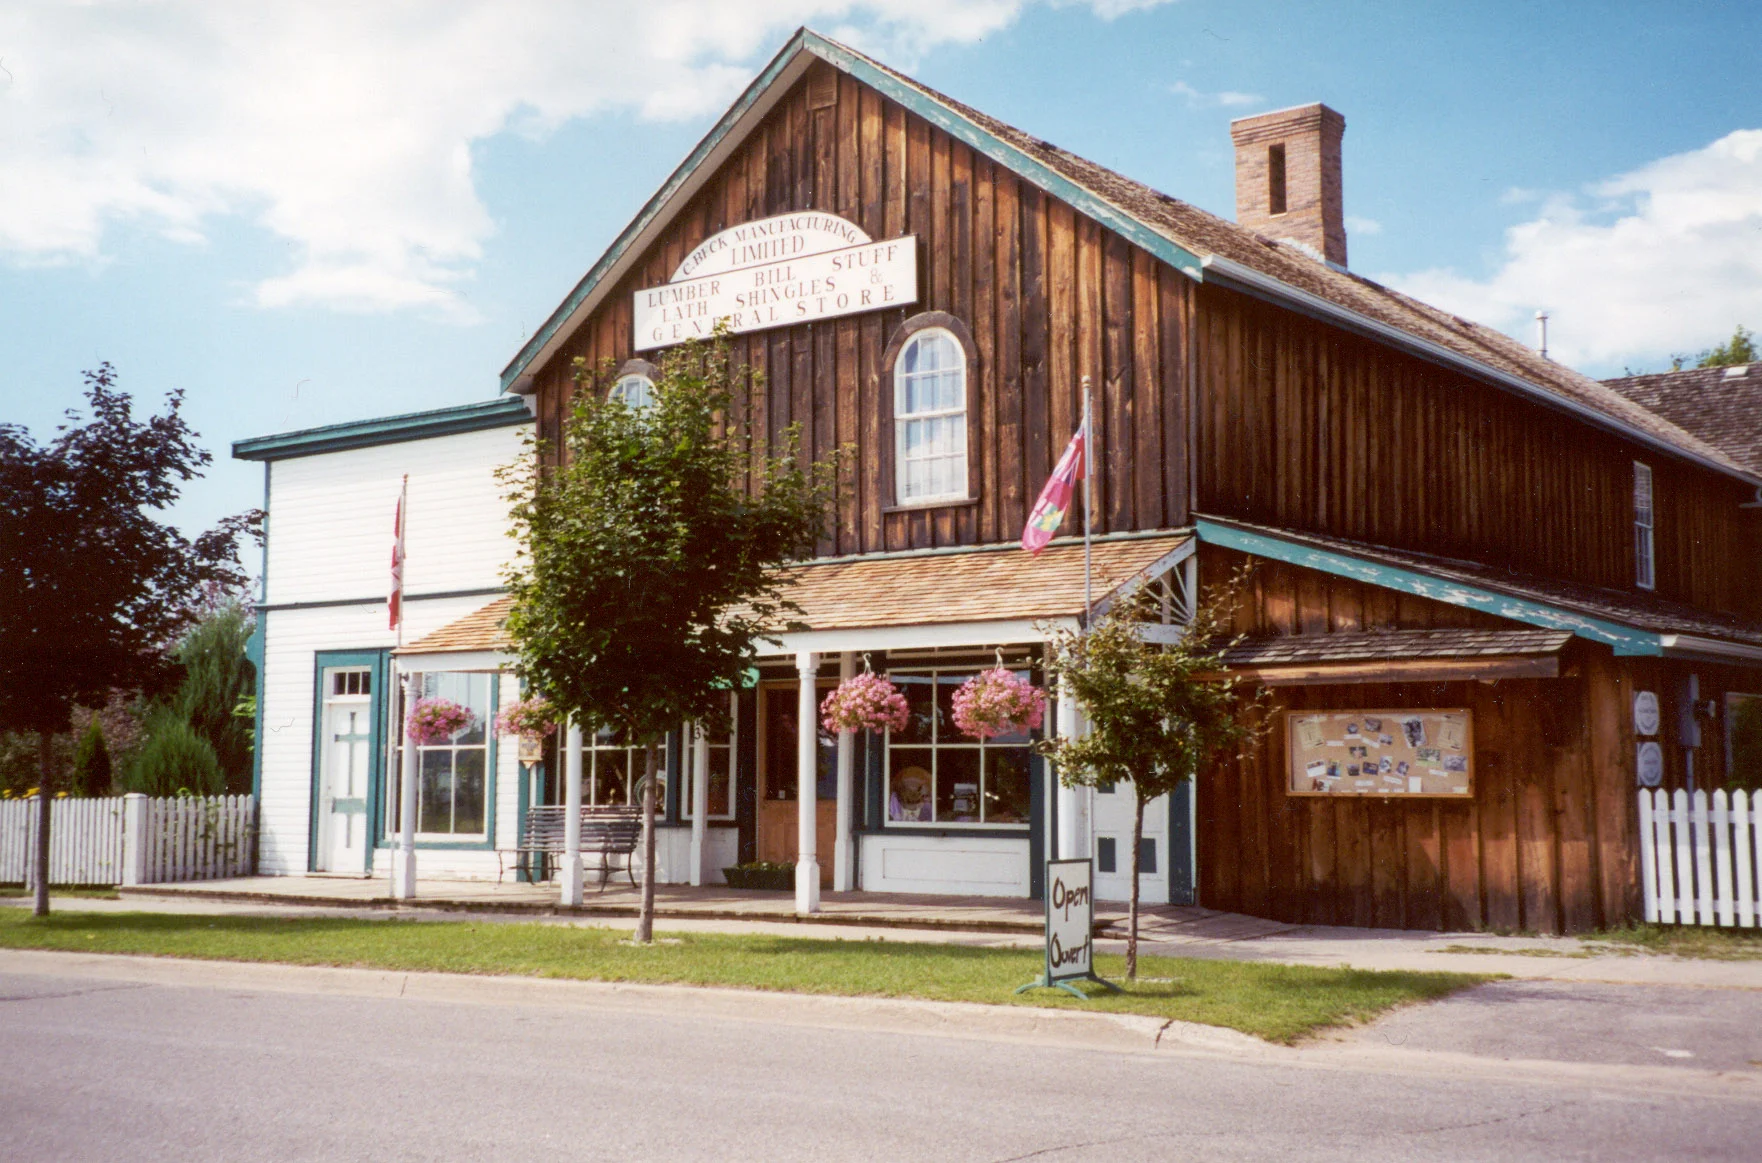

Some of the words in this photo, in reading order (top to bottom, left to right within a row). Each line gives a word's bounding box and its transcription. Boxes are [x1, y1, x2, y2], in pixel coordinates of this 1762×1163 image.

[735, 216, 857, 243] MANUFACTURING
[732, 234, 805, 265] LIMITED
[648, 281, 721, 308] LUMBER
[755, 266, 796, 287] BILL
[832, 245, 898, 272] STUFF
[662, 301, 708, 323] LATH
[736, 275, 836, 309] SHINGLES
[870, 268, 883, 285] &
[796, 284, 895, 317] STORE
[1053, 876, 1089, 922] Open
[1050, 932, 1089, 968] Ouvert
